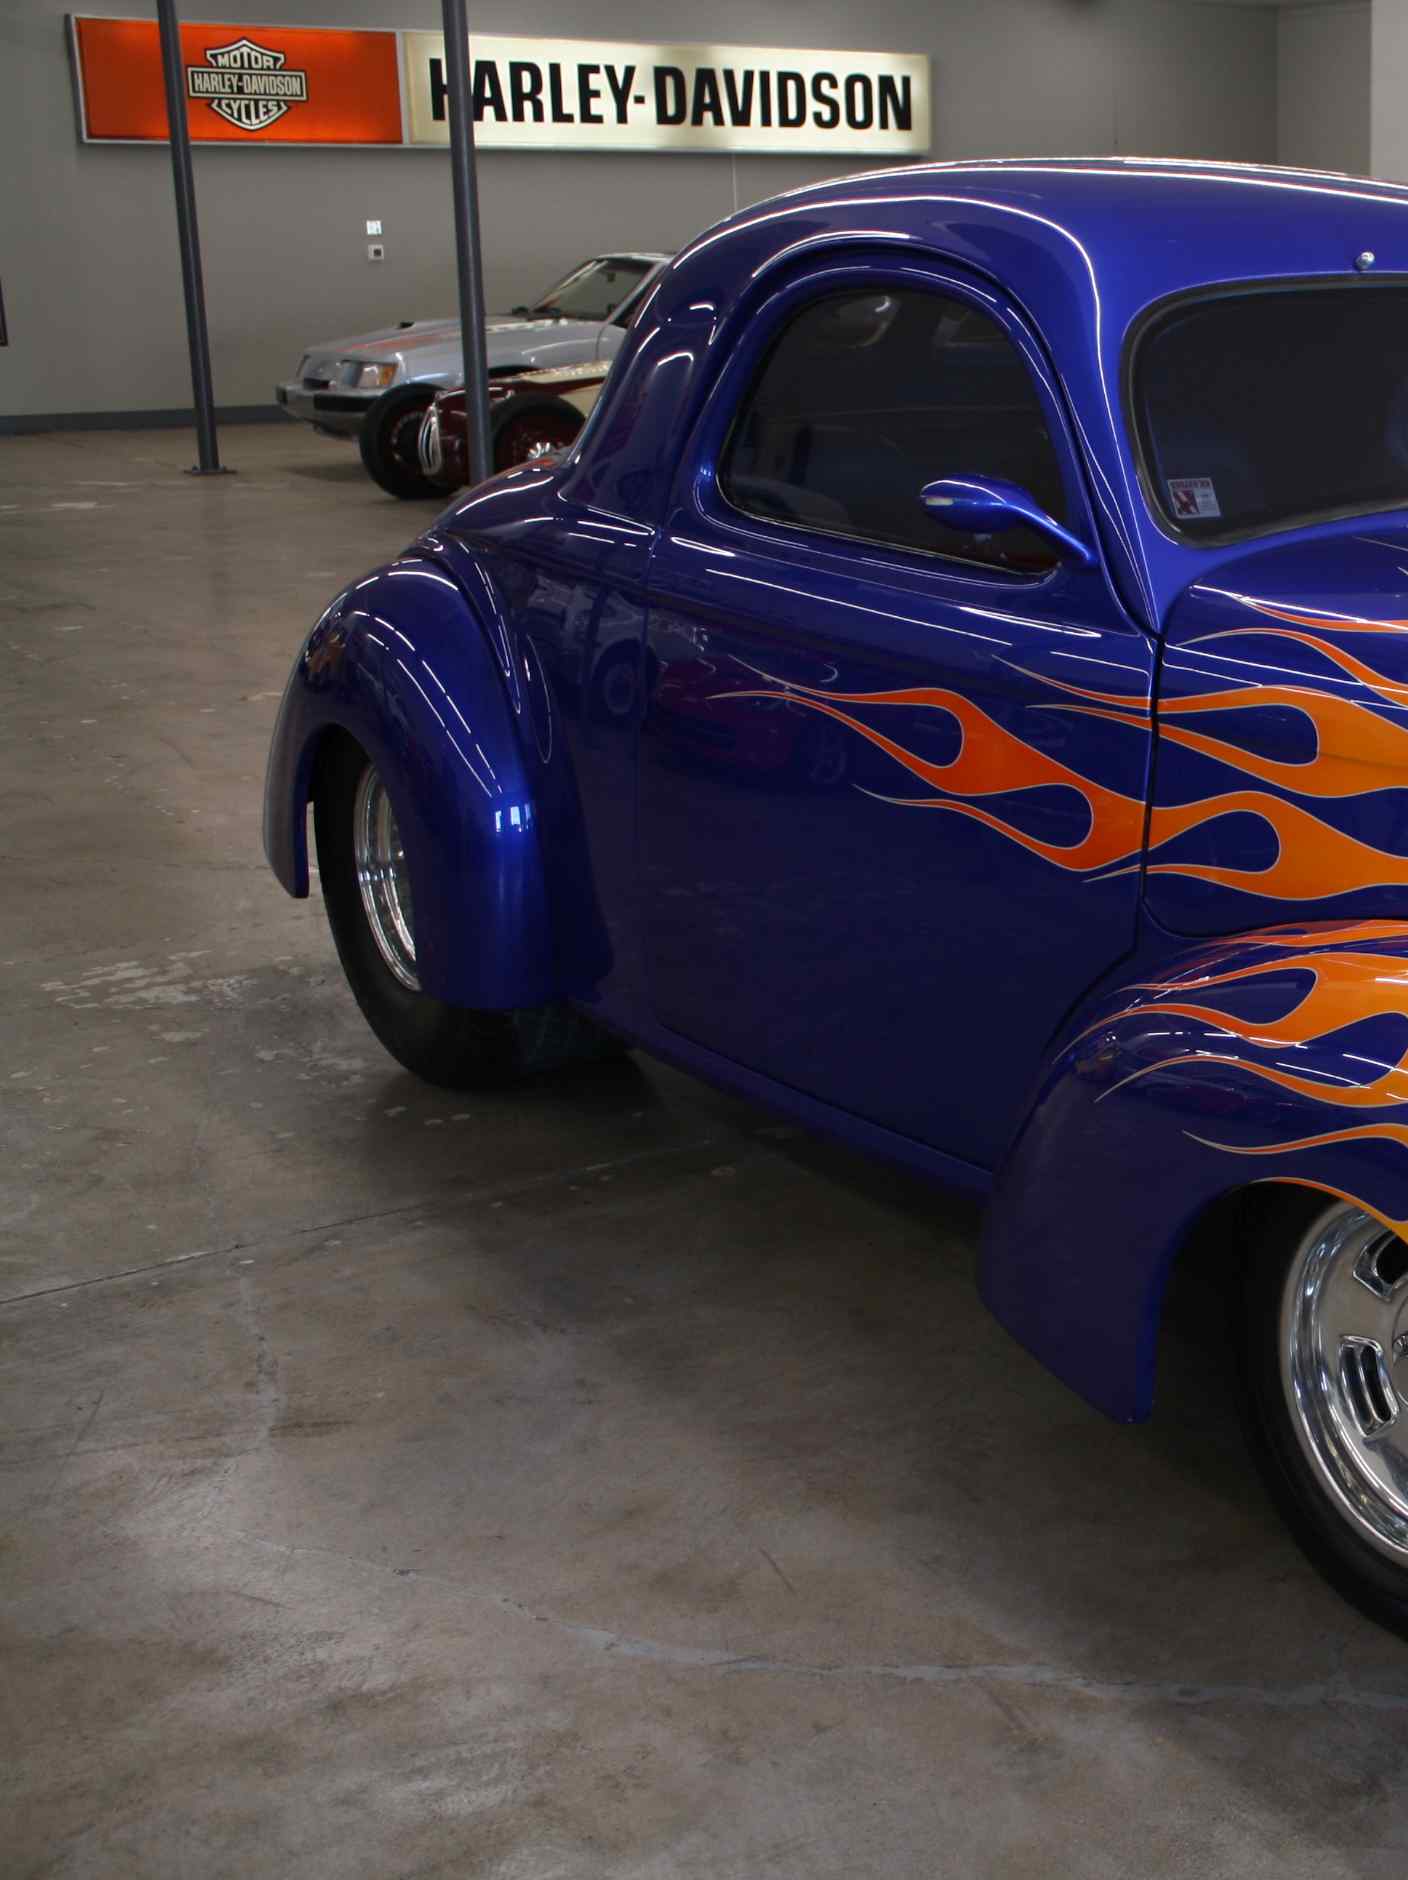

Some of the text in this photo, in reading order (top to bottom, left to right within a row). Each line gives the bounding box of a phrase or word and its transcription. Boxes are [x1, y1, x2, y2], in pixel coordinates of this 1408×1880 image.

[217, 46, 275, 70] MOTOR
[193, 72, 301, 96] HARLEY-DAVIDSON
[221, 99, 279, 125] CYCLES
